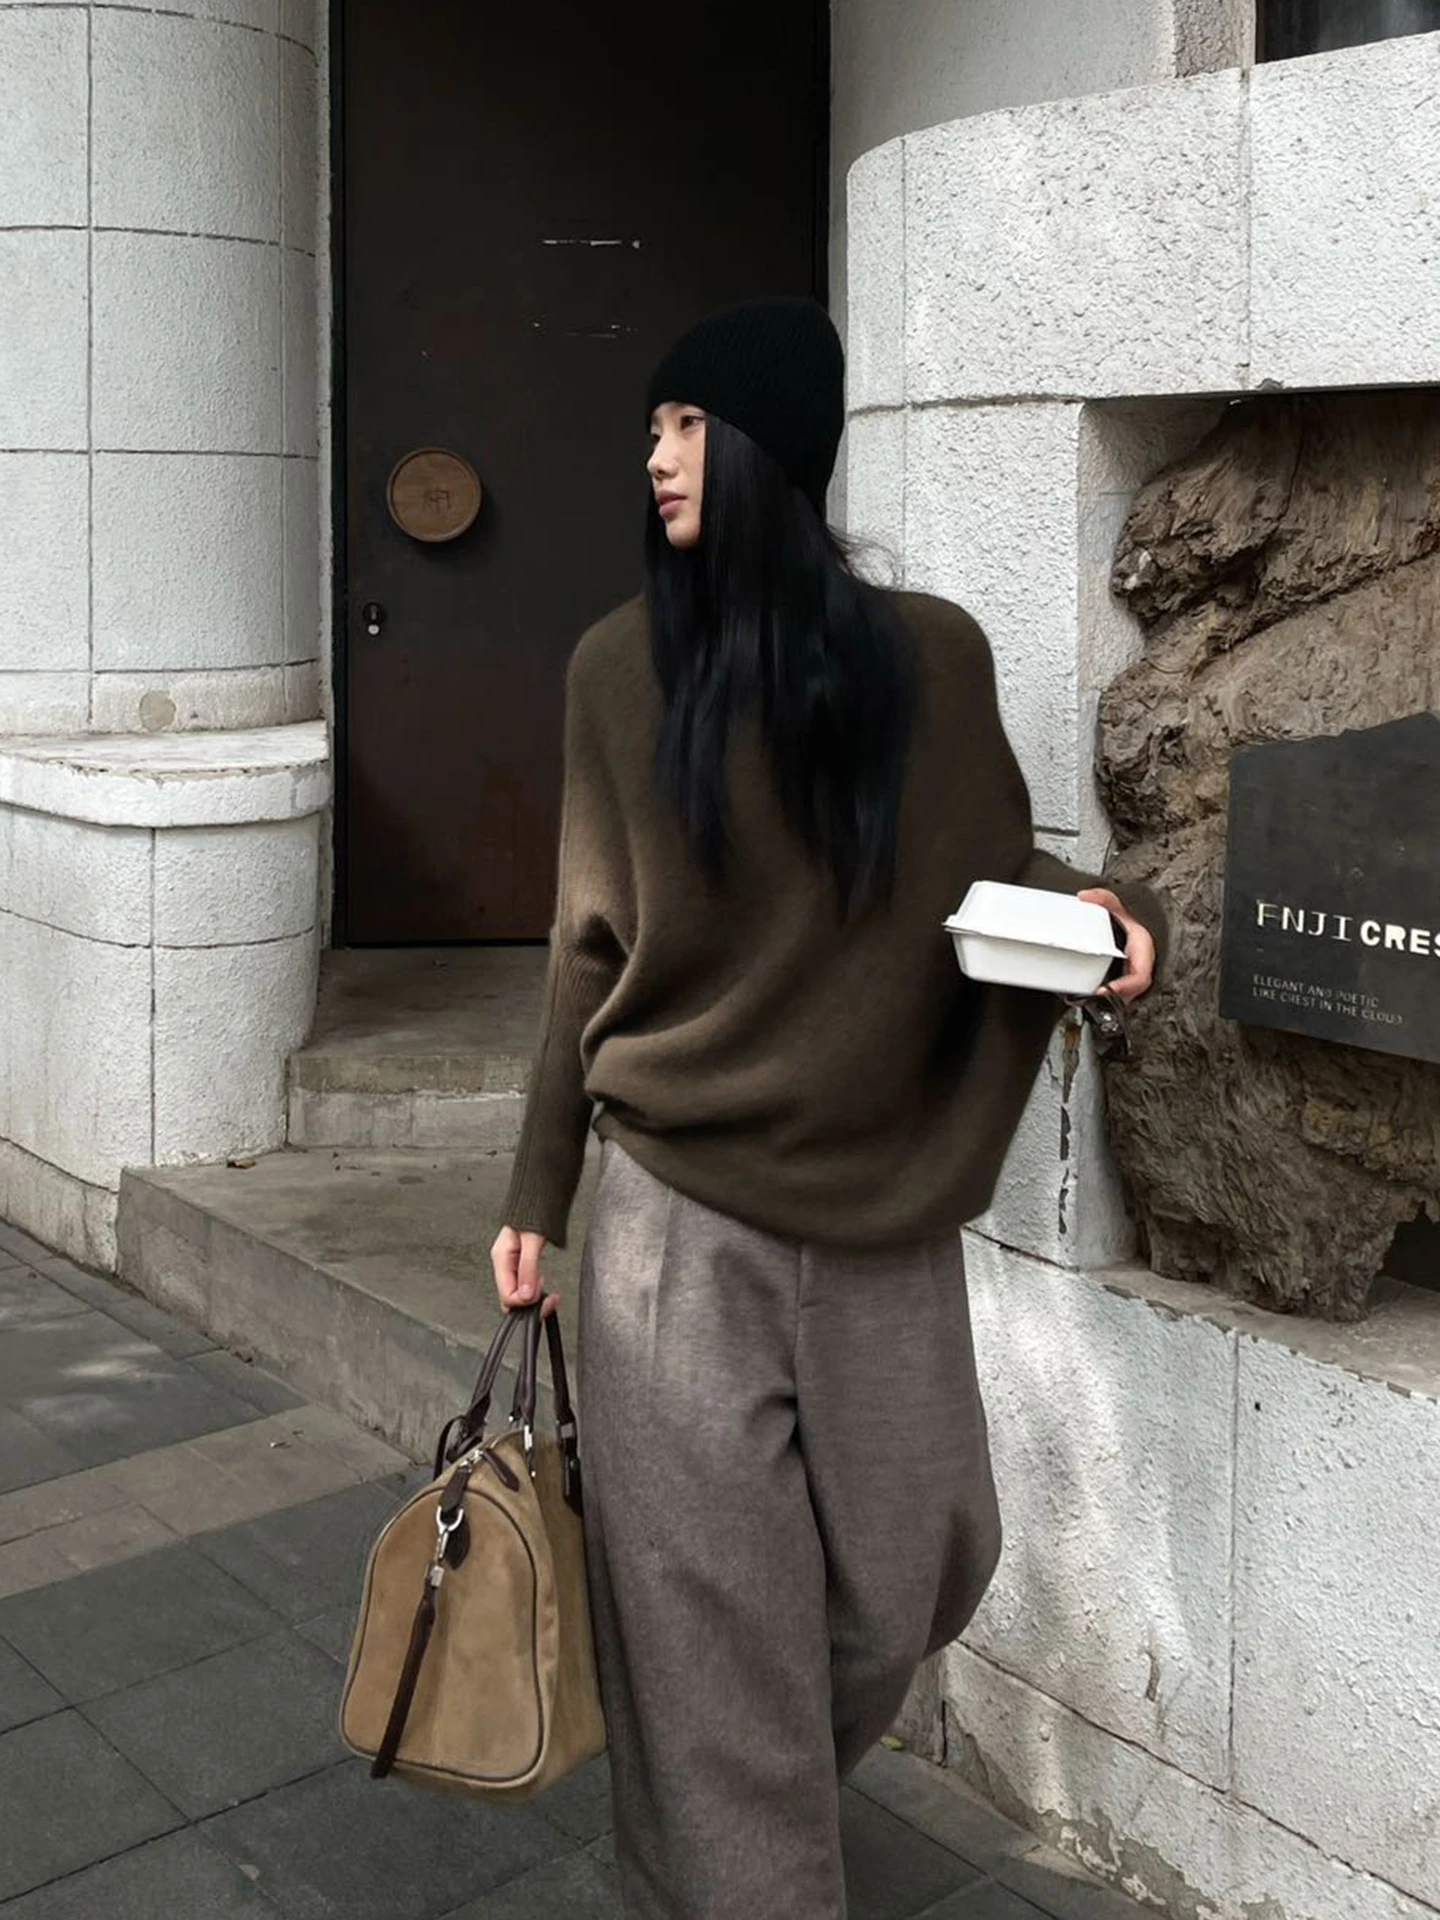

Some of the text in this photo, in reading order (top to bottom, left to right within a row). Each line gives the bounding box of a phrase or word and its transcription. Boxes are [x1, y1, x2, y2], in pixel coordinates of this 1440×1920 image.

[1256, 900, 1353, 942] FNJI
[1252, 986, 1276, 1000] LIKE
[1319, 1000, 1332, 1012] IN
[1336, 1002, 1357, 1017] THE
[1253, 974, 1304, 992] ELEGANT
[1336, 990, 1379, 1008] POETIC
